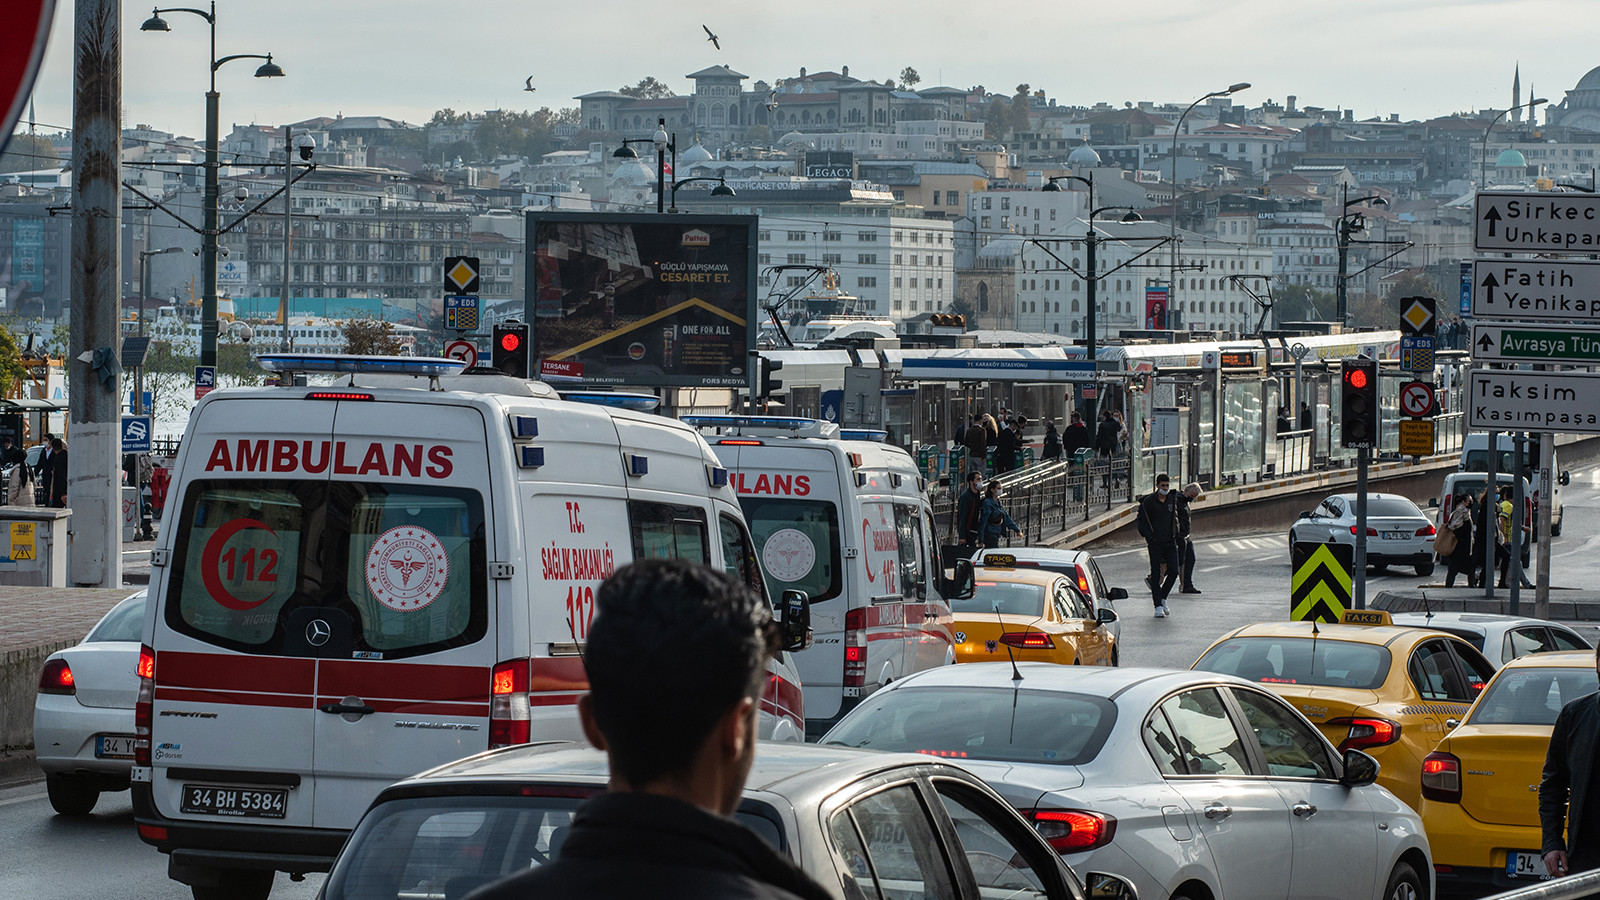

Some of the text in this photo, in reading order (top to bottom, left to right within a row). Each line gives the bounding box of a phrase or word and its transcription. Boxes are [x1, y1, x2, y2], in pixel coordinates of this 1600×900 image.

[806, 166, 852, 177] LEGACY
[1507, 200, 1595, 220] Sirkec
[660, 262, 729, 272] GÜÇLÜ YAPIŞMAYA
[660, 272, 731, 283] CESARET ET.
[1504, 268, 1573, 287] Fatih
[1504, 292, 1600, 316] Yenikap
[682, 325, 731, 335] ONE FOR ALL
[1416, 340, 1431, 348] EDS
[1503, 334, 1600, 356] Avrasya Tün
[543, 362, 571, 371] TERSANE
[1478, 379, 1576, 401] Taksim
[1476, 406, 1597, 426] Kasımpaşa
[204, 439, 454, 479] AMBULANS
[565, 501, 585, 534] T.C.
[222, 547, 278, 582] 112
[541, 540, 615, 581] SAĞLIK BAKANLIĞI
[883, 559, 896, 595] 112
[566, 585, 594, 640] 112
[159, 710, 218, 719] SPRINTER
[417, 721, 480, 731] BLUETEC
[104, 739, 118, 752] 34
[191, 789, 282, 811] 34 BH 5384
[1517, 855, 1534, 873] 34
